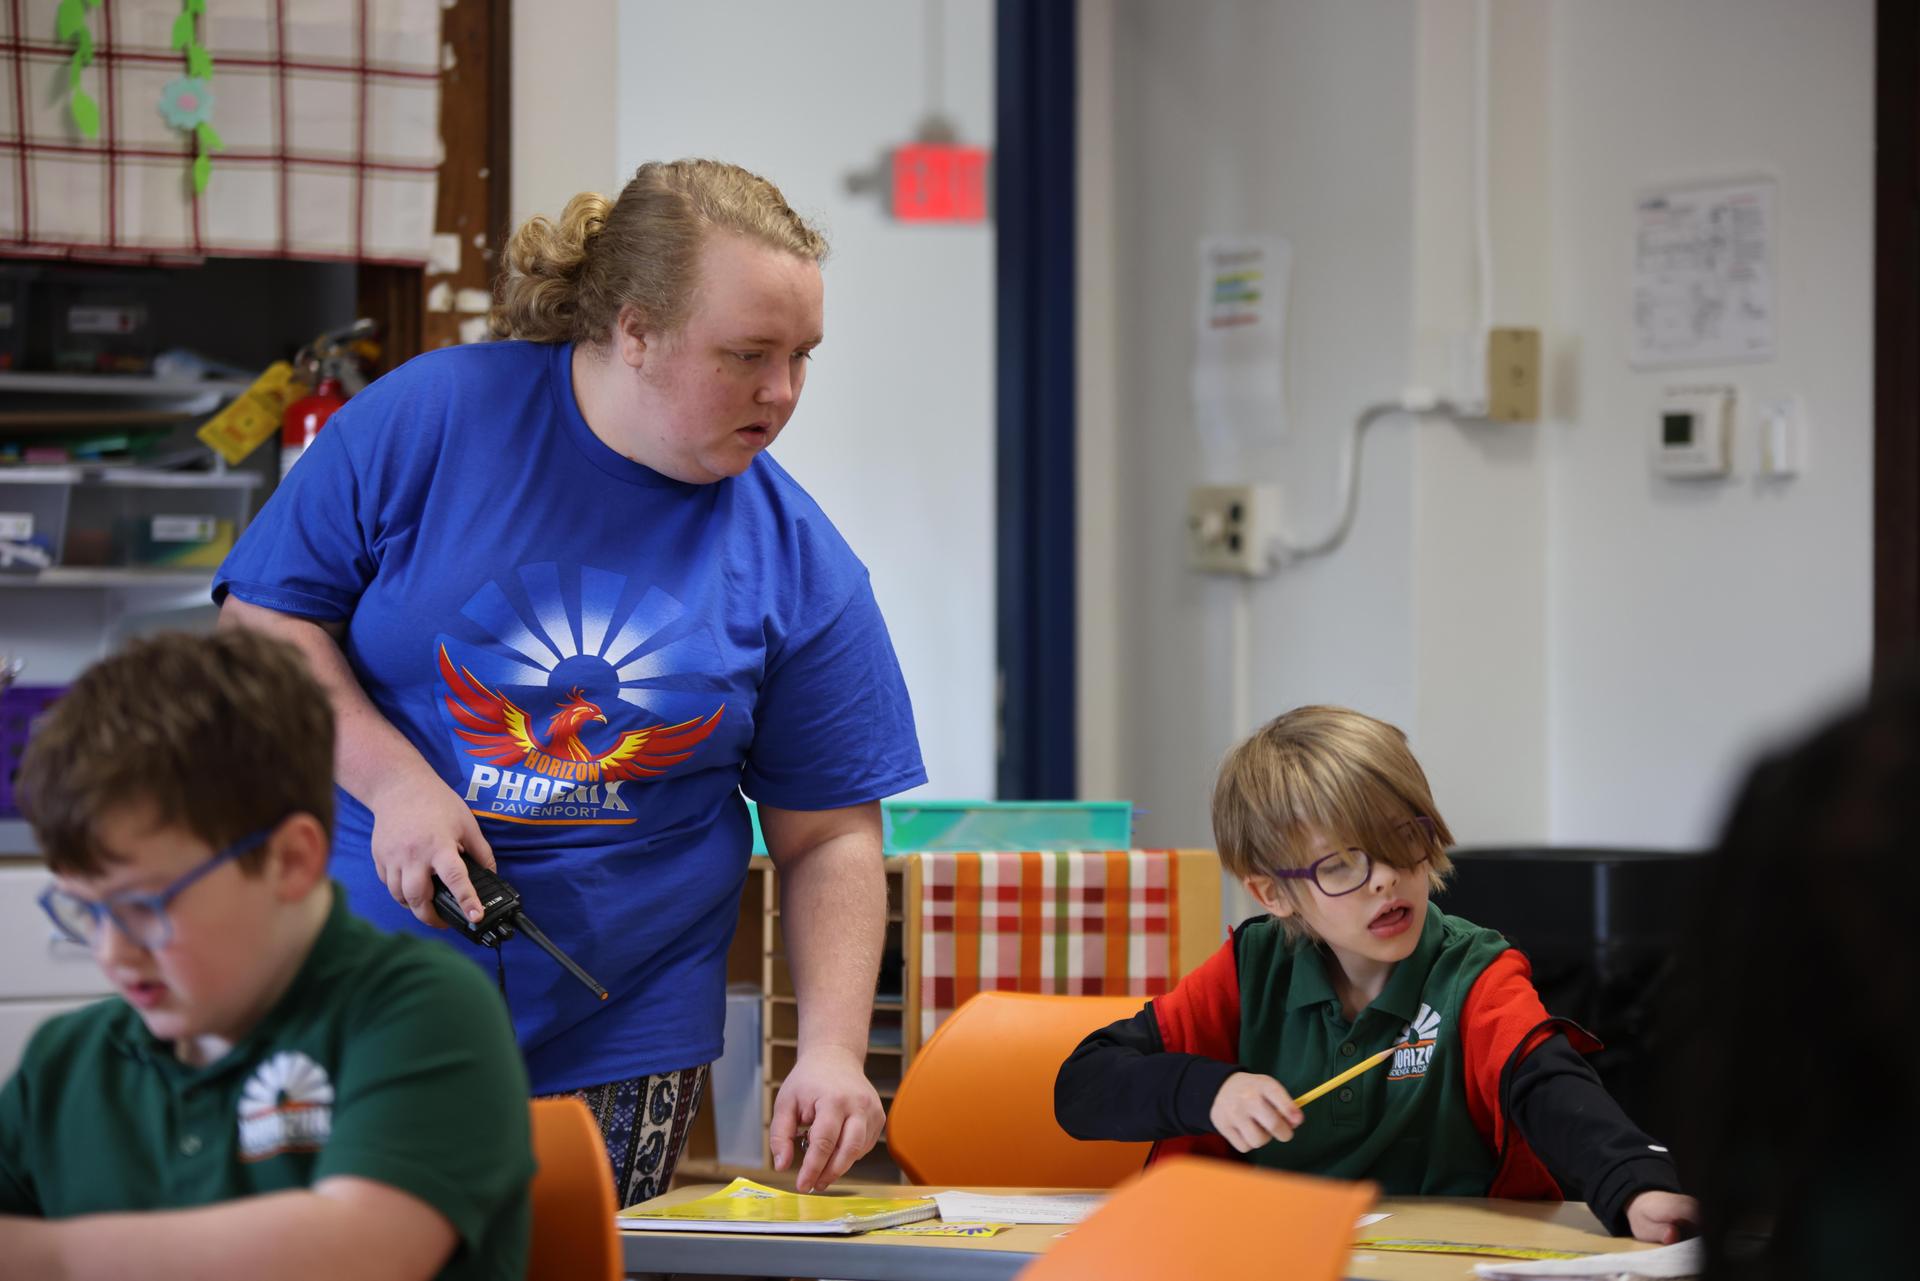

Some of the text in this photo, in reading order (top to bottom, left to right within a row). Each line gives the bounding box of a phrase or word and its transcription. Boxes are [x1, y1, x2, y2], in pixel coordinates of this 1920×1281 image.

[524, 749, 600, 782] HORIZON
[464, 764, 629, 812] PHOENIX
[491, 801, 600, 818] DAVENPORT
